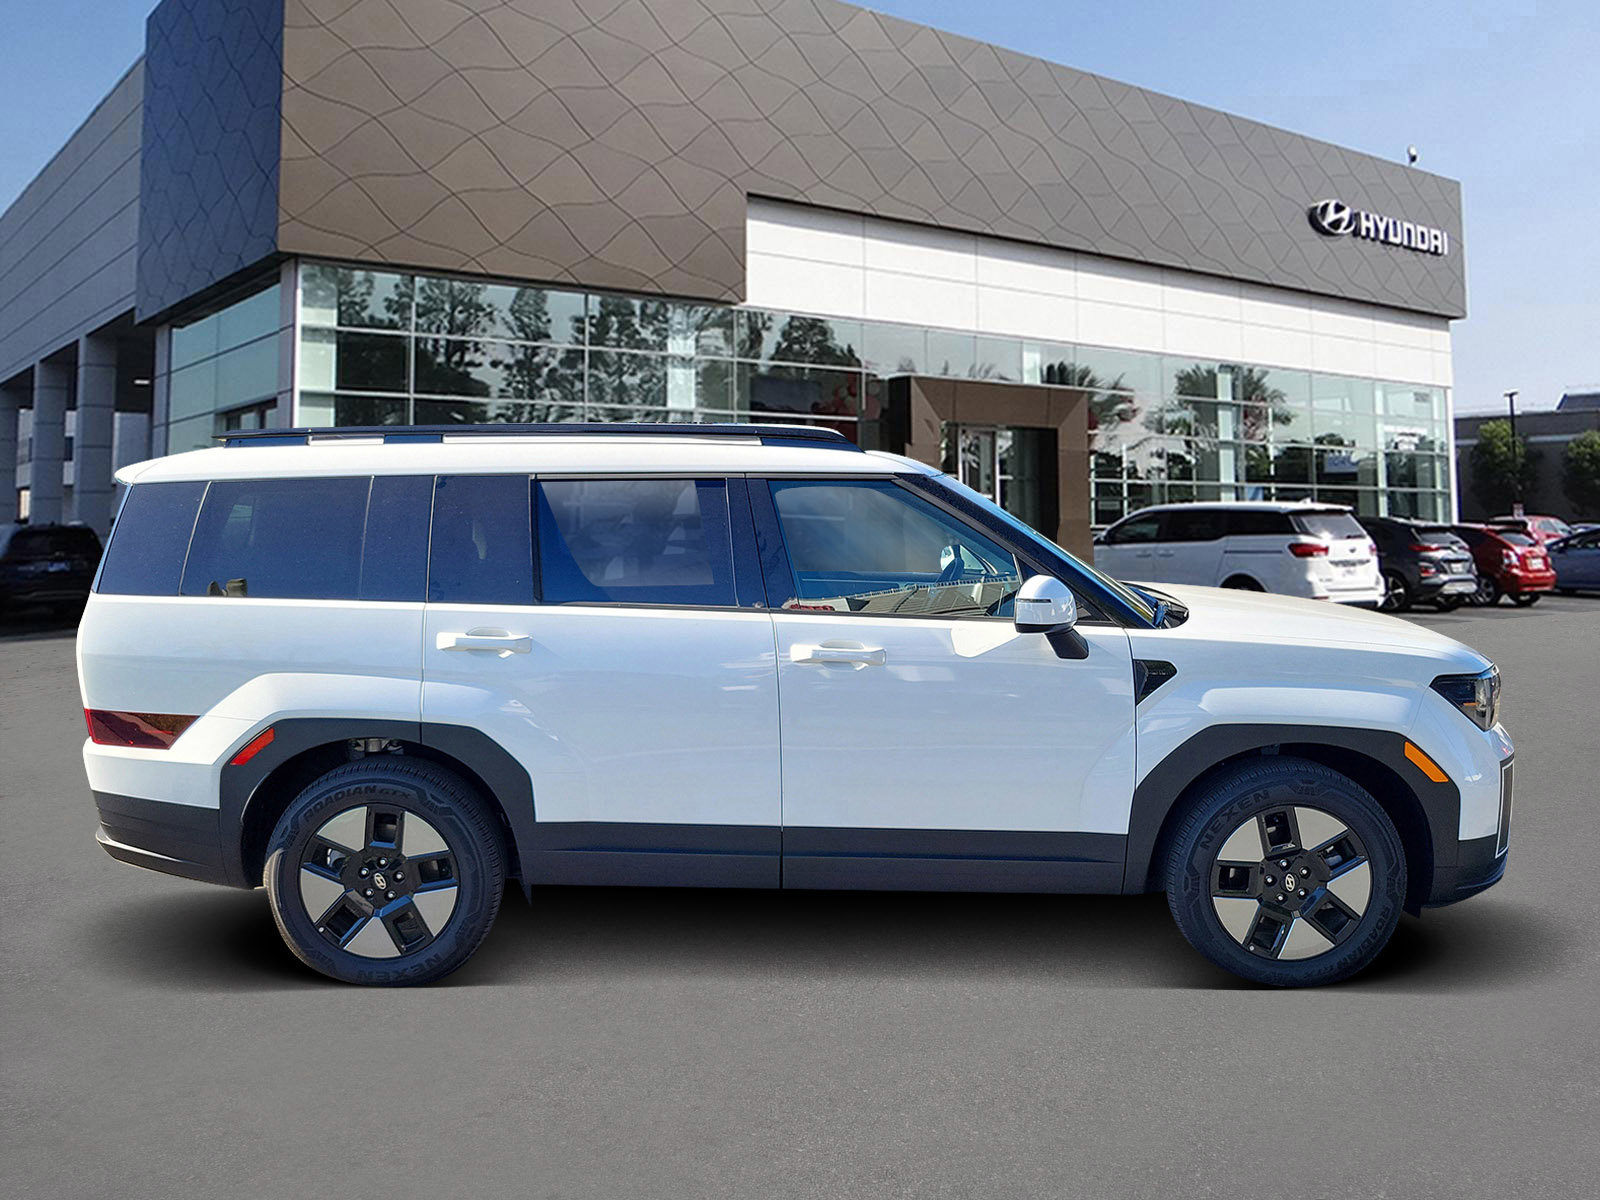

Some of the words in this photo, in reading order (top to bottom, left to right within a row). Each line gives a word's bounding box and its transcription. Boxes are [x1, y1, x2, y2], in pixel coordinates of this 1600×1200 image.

[1360, 211, 1448, 255] HYUNDAI
[303, 785, 377, 821] ROADIAN
[1200, 789, 1270, 850] NEXEN
[357, 953, 443, 982] NEXEN
